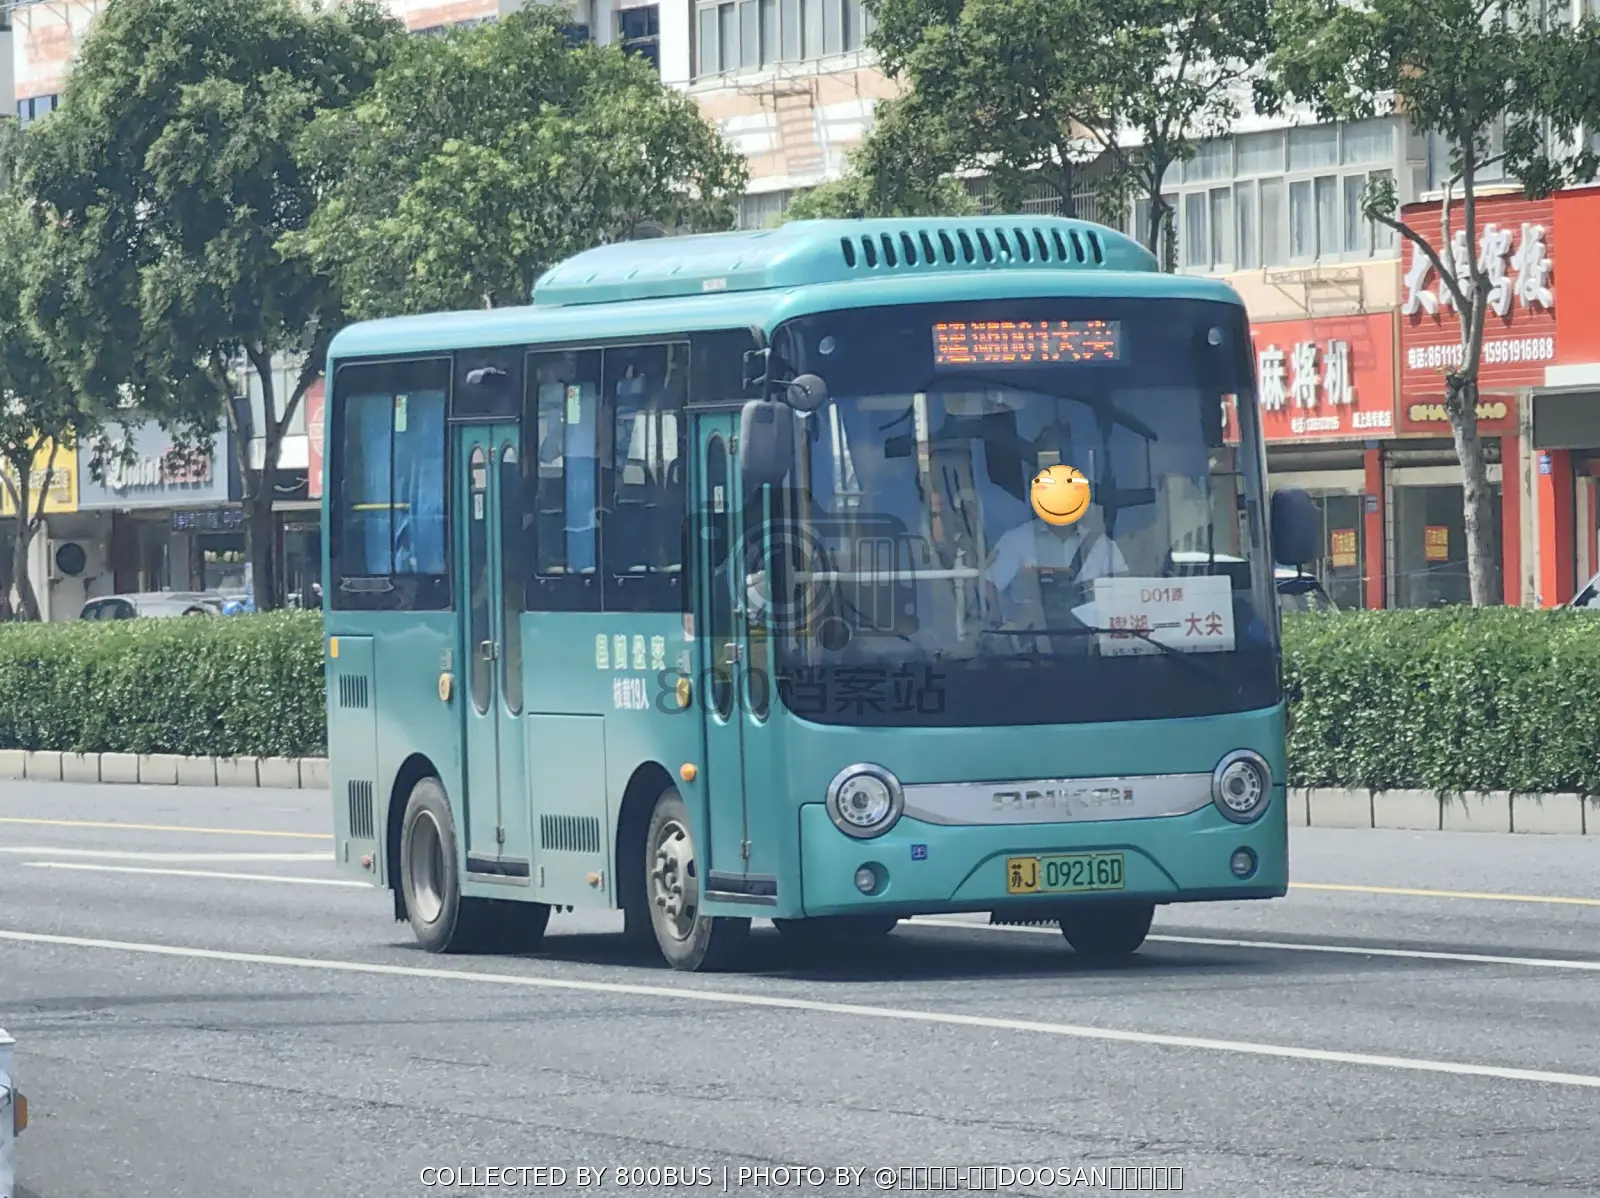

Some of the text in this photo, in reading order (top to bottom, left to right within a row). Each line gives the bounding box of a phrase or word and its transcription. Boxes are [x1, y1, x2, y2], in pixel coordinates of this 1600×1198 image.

[1483, 337, 1554, 364] 15961916888
[1259, 338, 1353, 411] 麻将机
[1140, 587, 1184, 603] D01路
